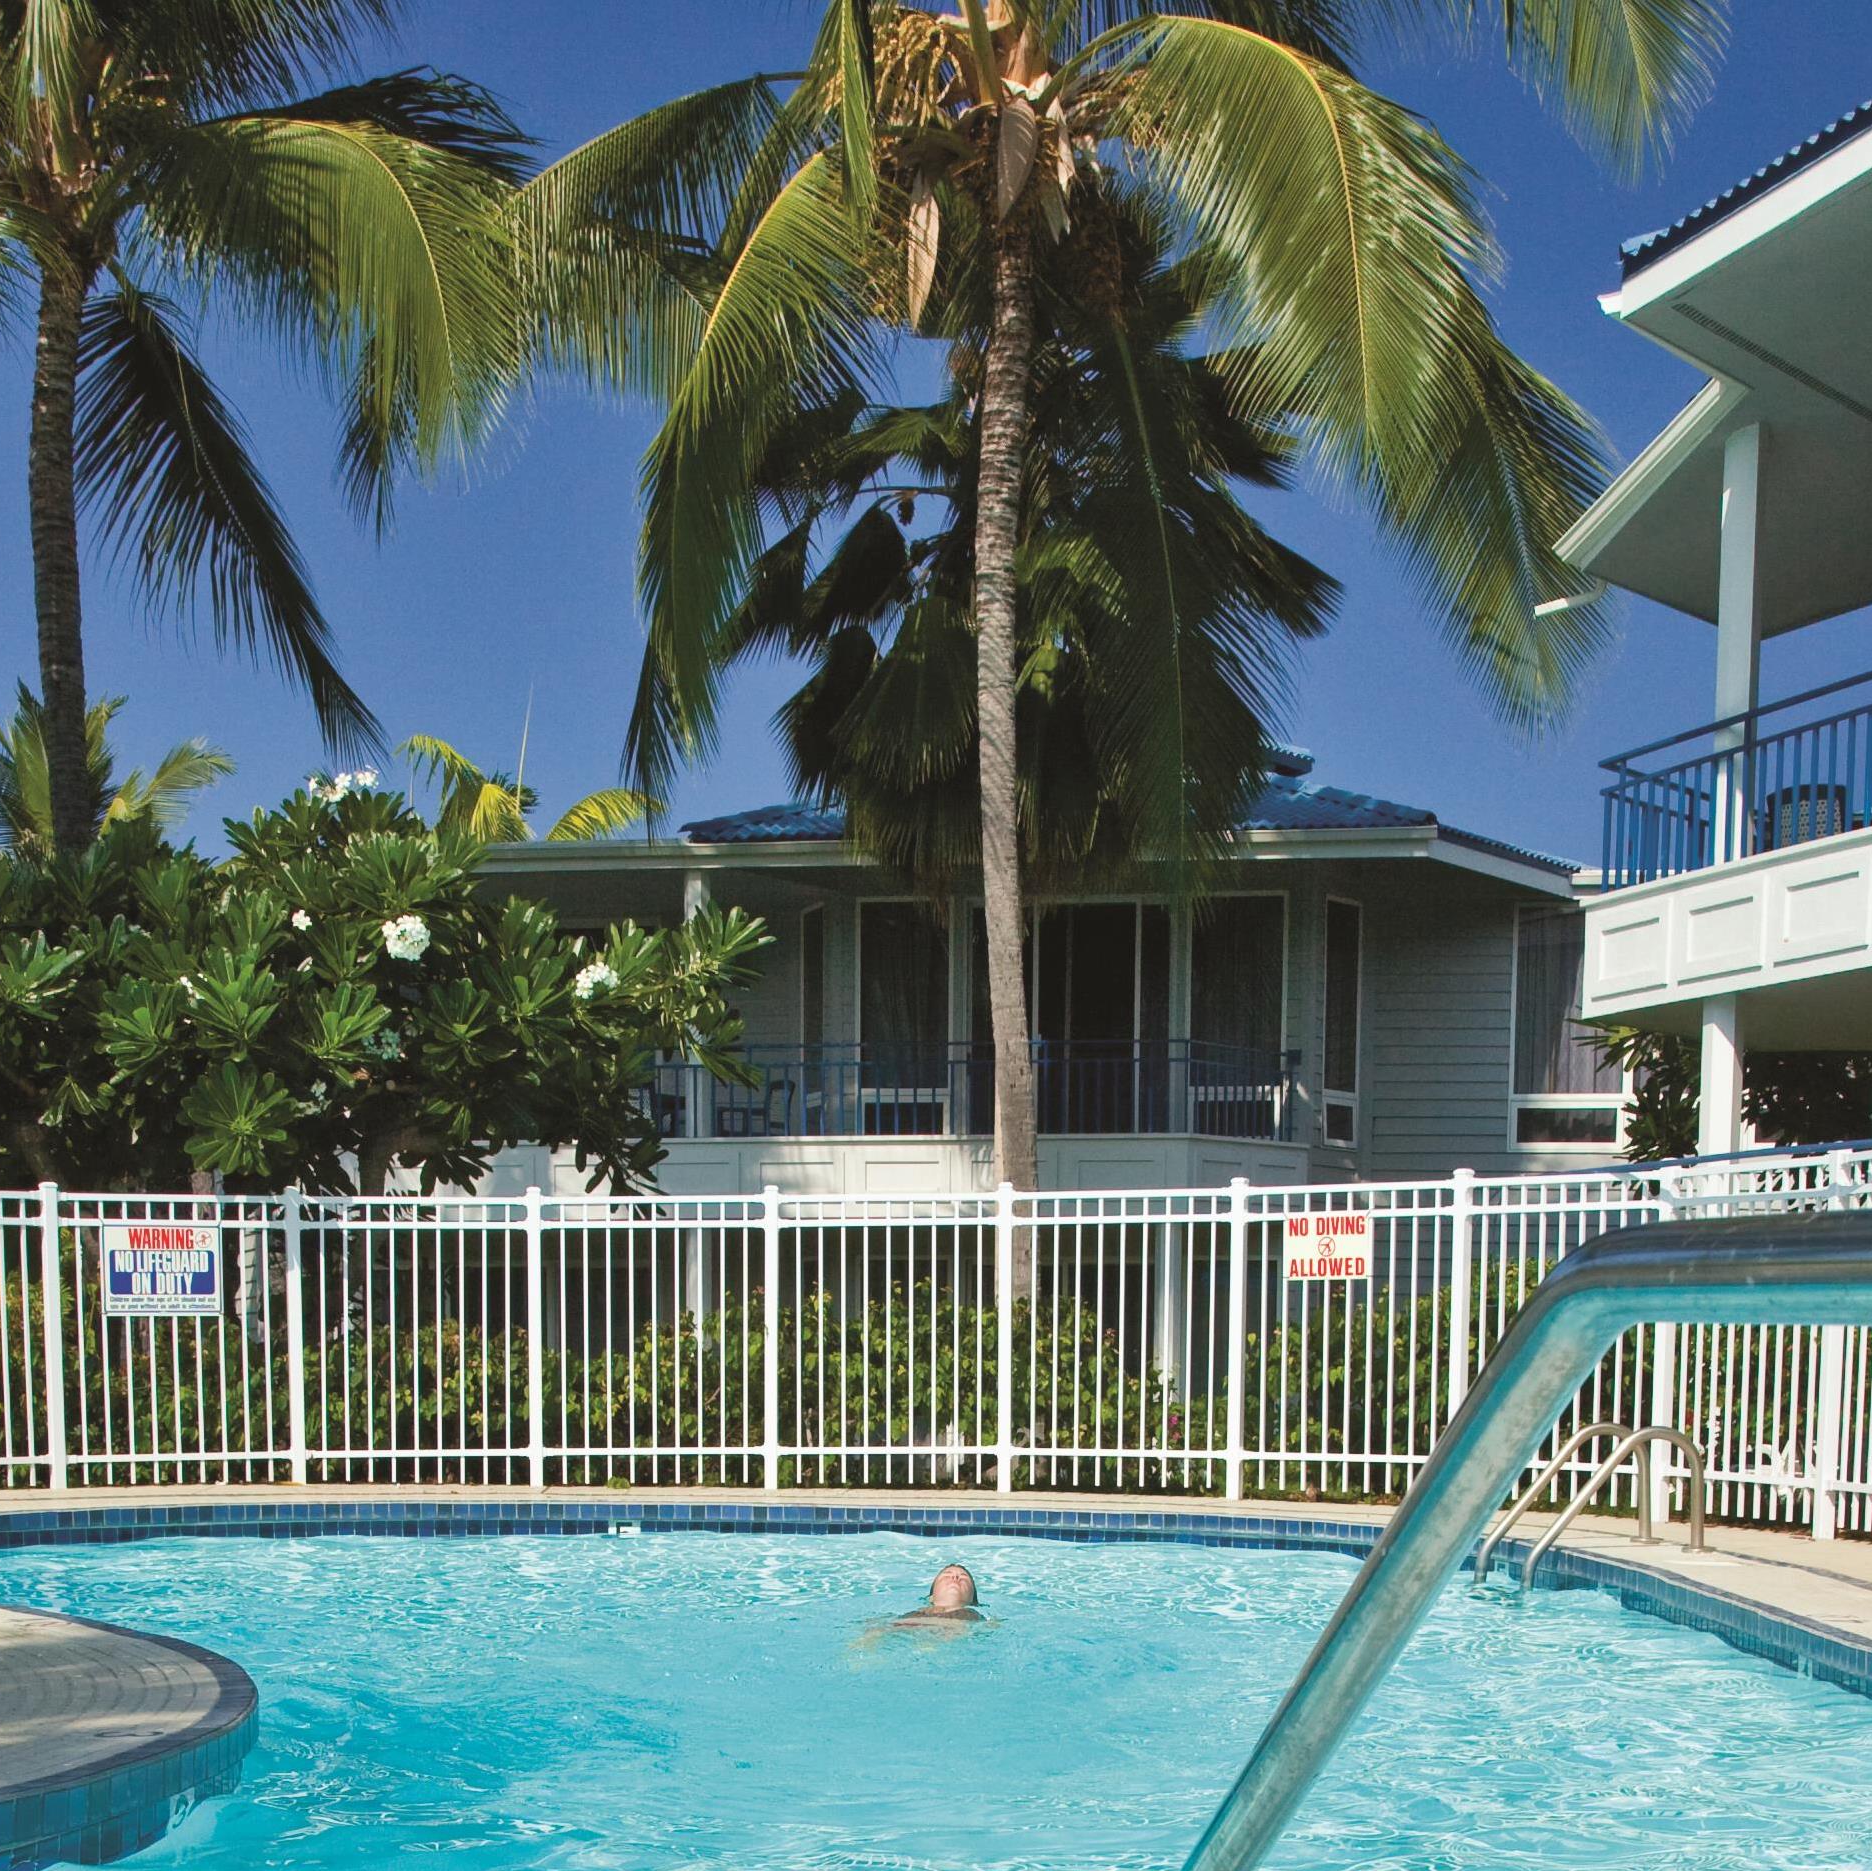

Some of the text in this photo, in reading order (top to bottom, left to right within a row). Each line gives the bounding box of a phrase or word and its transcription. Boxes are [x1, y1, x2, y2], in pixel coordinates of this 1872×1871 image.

[1289, 1215, 1365, 1237] NO DIVING
[128, 1228, 194, 1249] WARNING
[114, 1250, 209, 1273] NO LIFEGUARD
[1289, 1257, 1365, 1277] ALLOWED
[131, 1272, 193, 1294] ON DUTY
